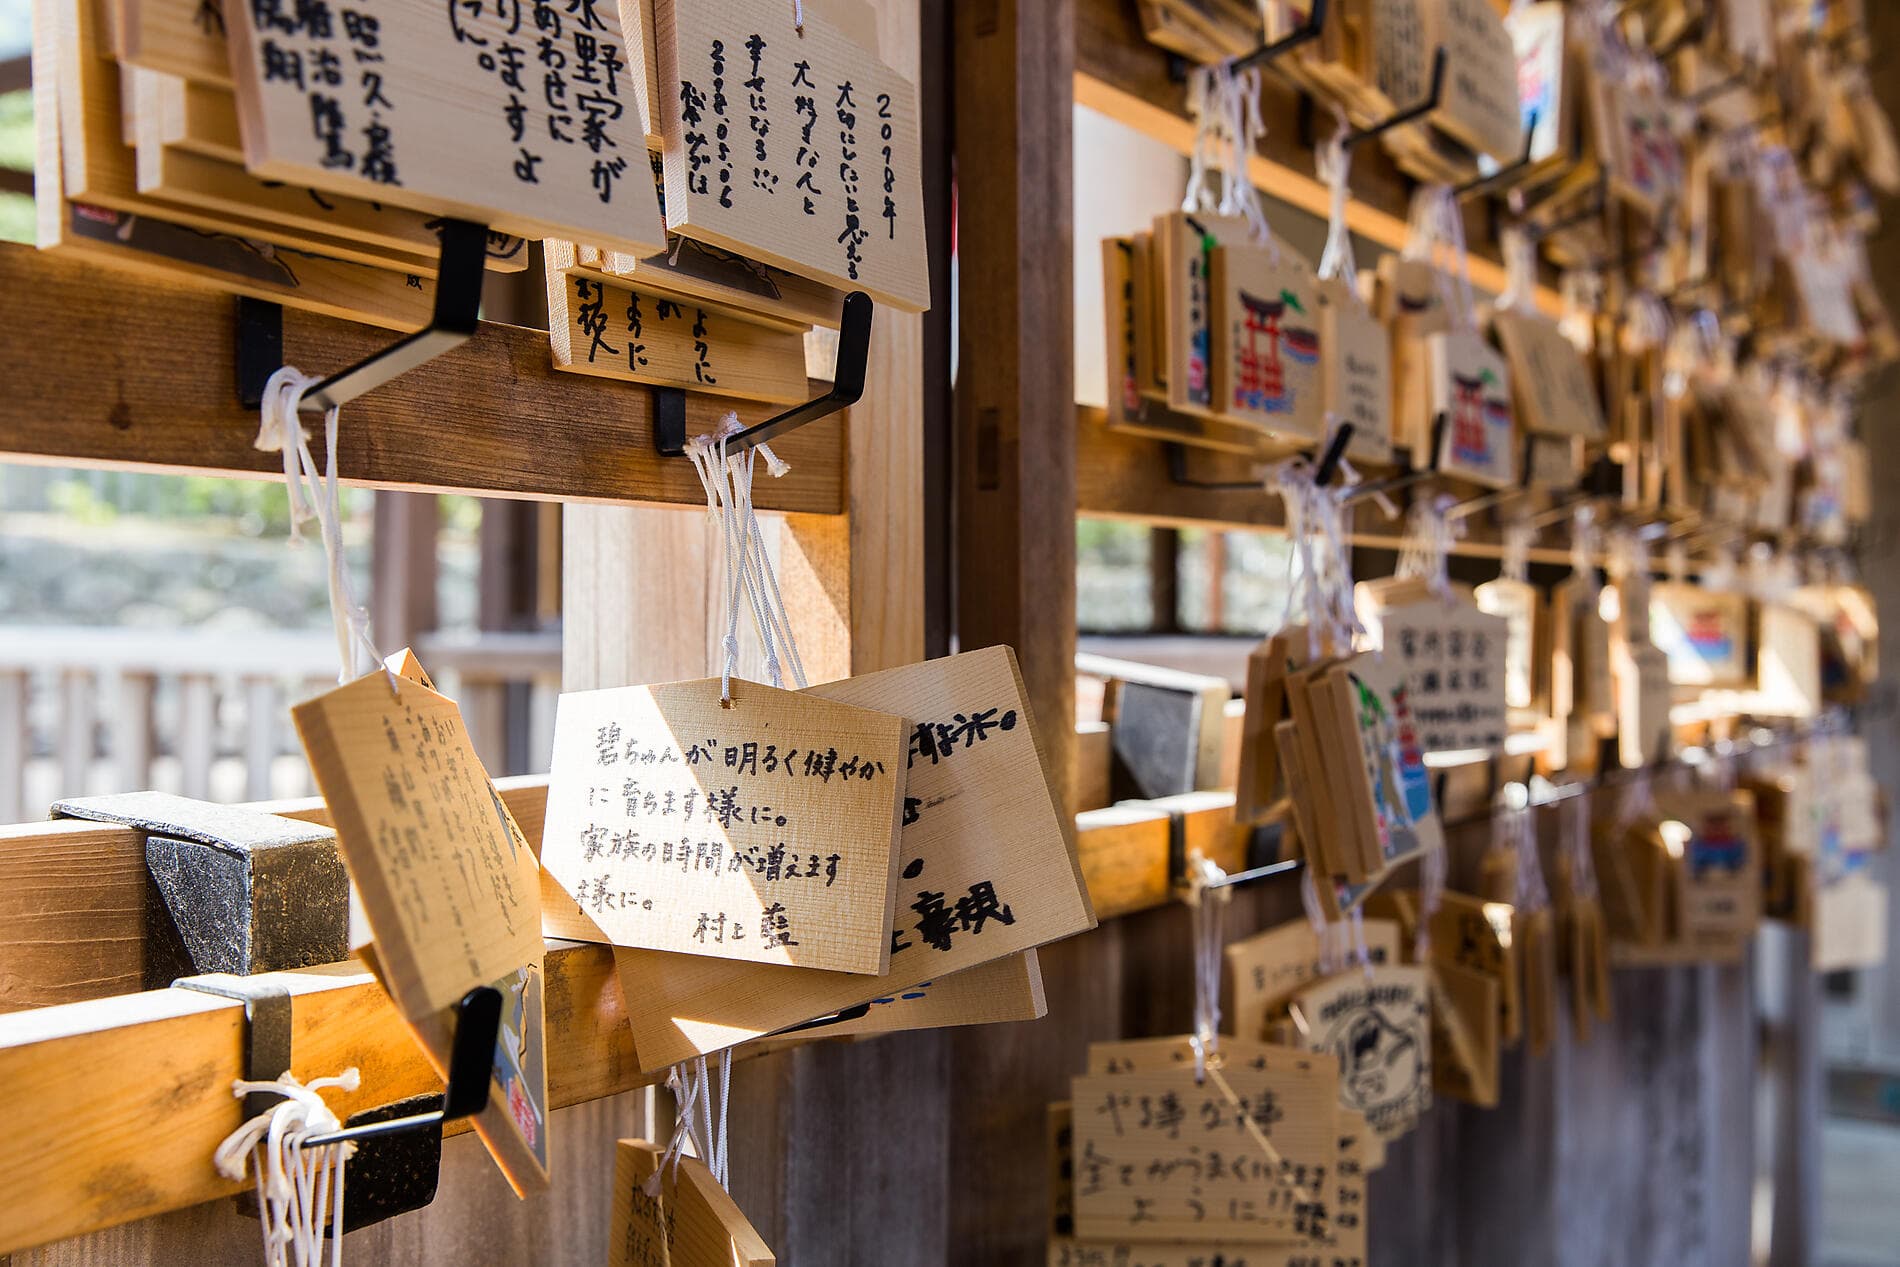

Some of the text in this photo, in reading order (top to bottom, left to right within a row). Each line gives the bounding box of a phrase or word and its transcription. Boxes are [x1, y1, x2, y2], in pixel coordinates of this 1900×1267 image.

[533, 0, 574, 143] あわせに
[565, 0, 628, 204] 水野家が
[596, 722, 885, 784] 碧ちゃんが明るく健やか
[589, 777, 788, 829] に育ちます様に。
[580, 822, 842, 888] 家族の時間が増えます
[575, 874, 653, 916] 様に。
